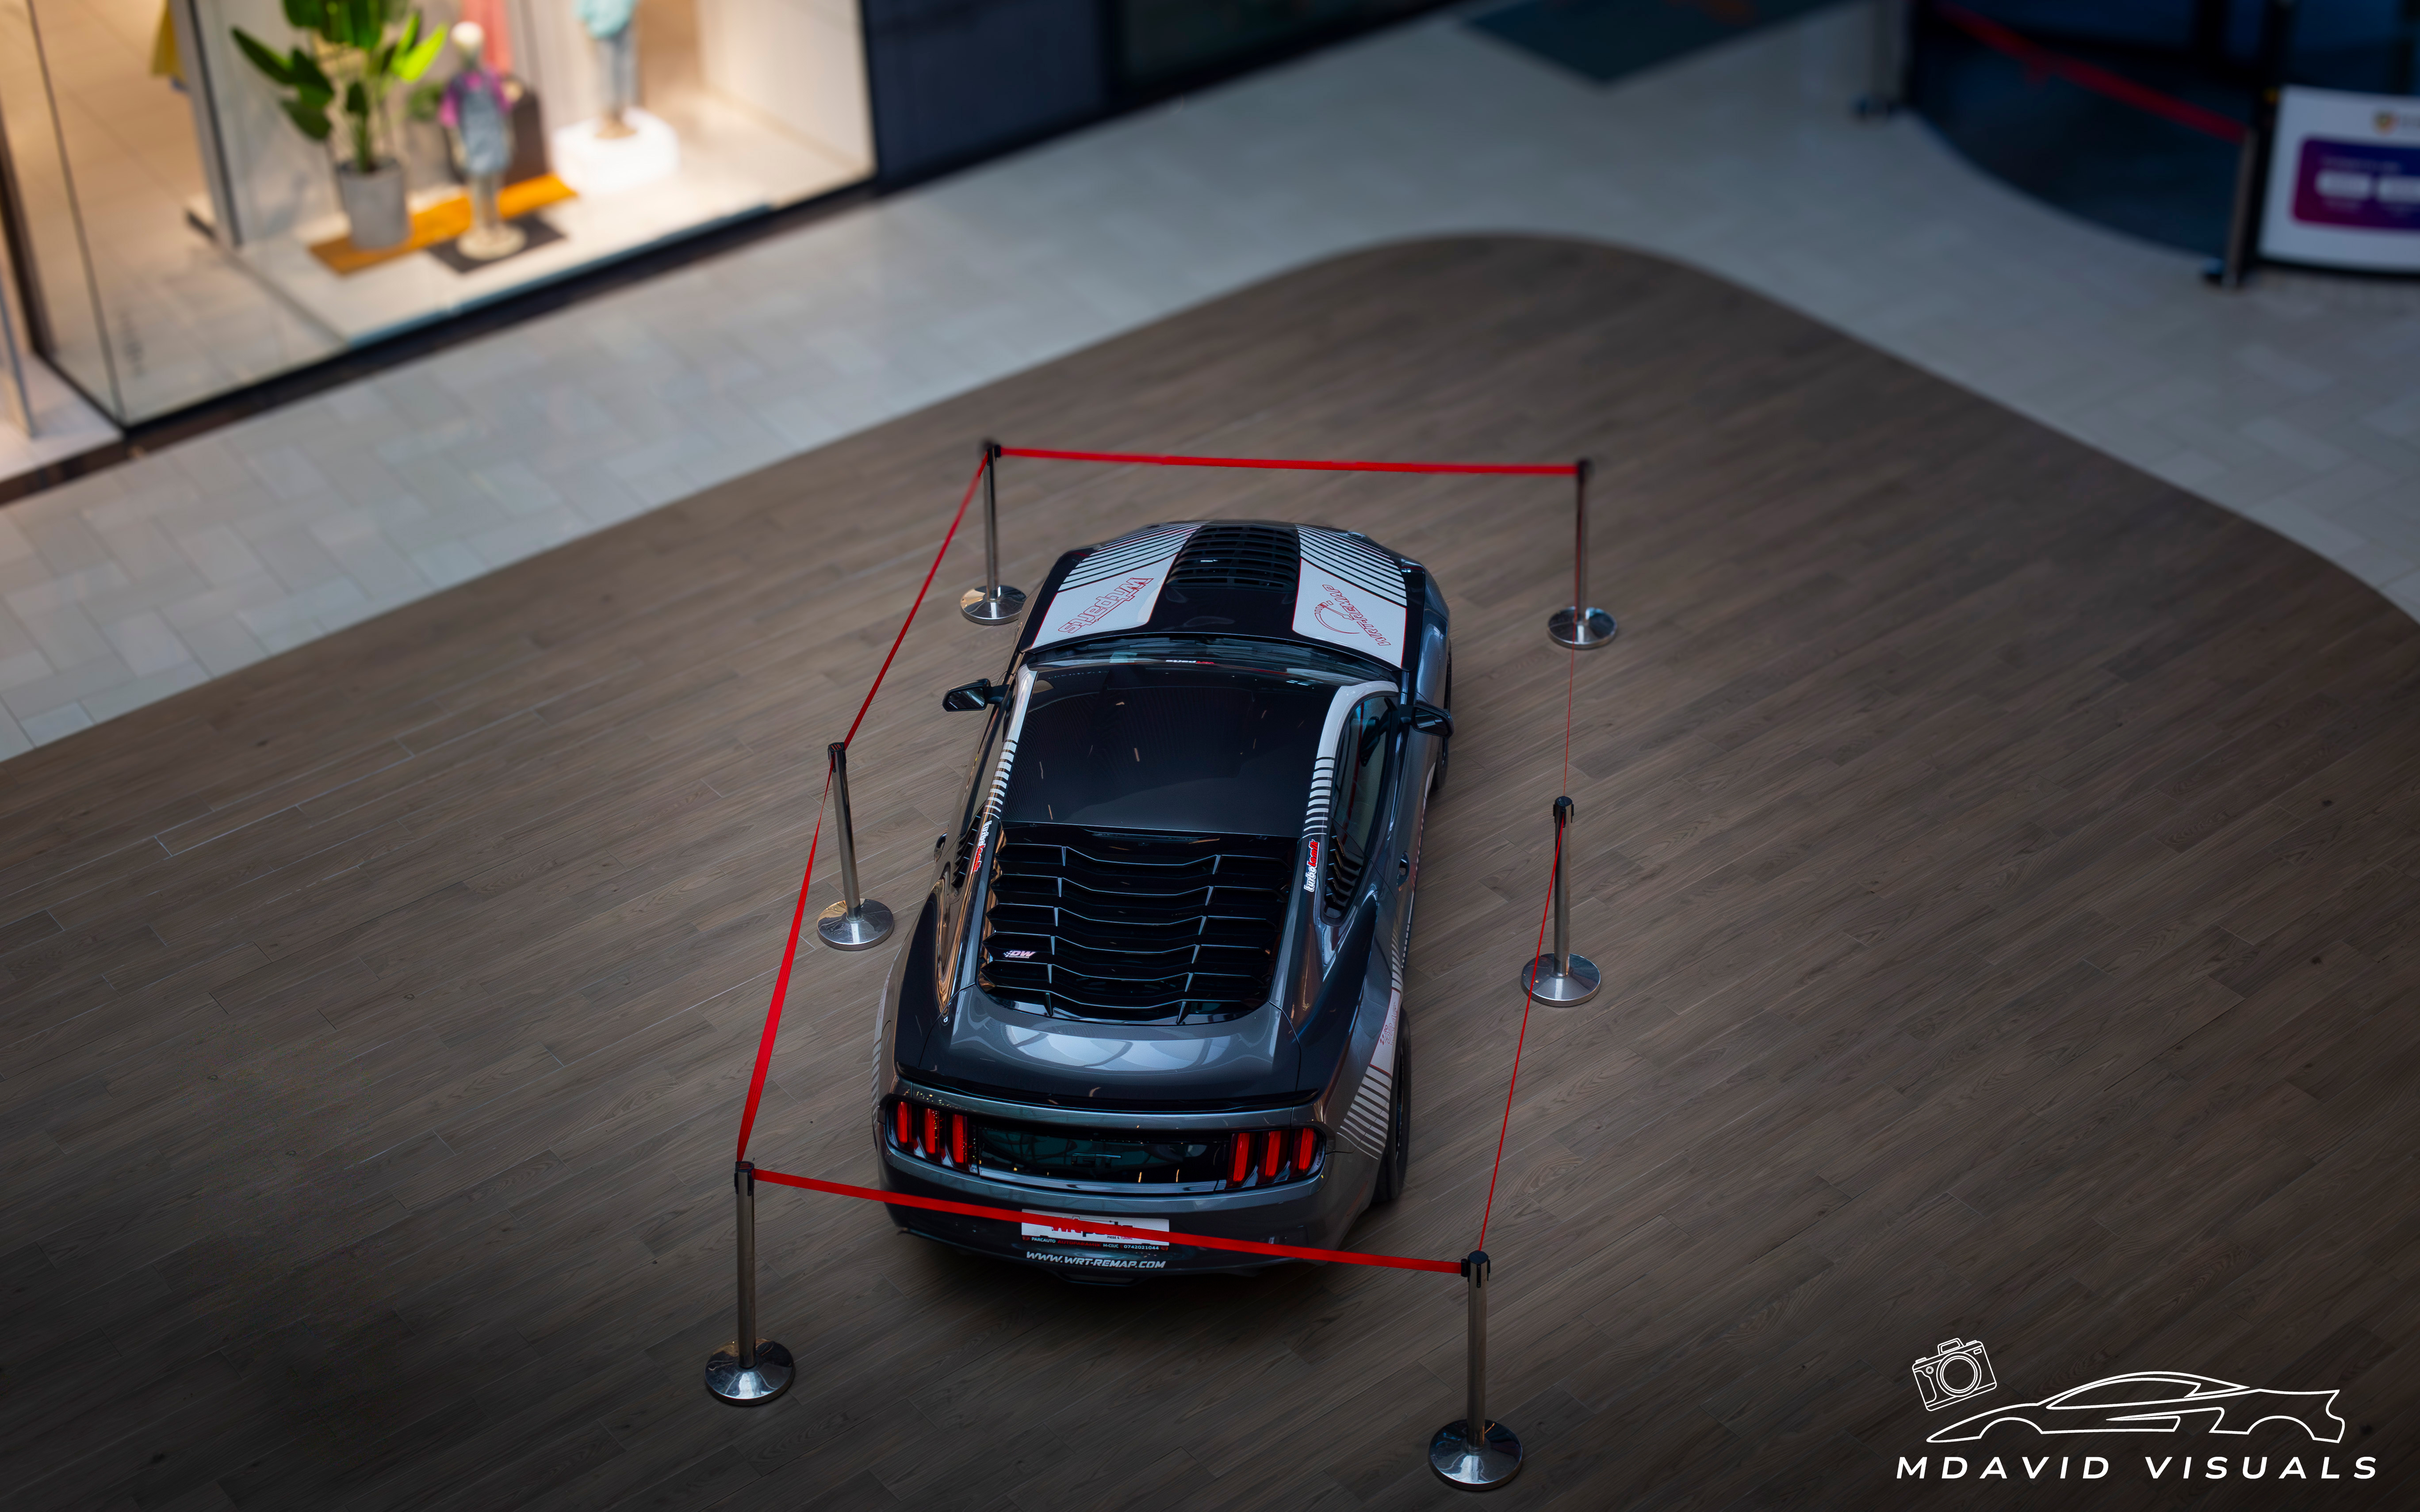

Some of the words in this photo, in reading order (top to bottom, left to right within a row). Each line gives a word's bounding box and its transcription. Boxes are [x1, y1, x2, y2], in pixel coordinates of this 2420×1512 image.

[1322, 584, 1391, 646] WRT-REMAP
[1304, 839, 1320, 892] turbolamik
[1071, 1152, 1122, 1168] GT
[1026, 1251, 1166, 1268] WWW.WRT-REMAP.COM
